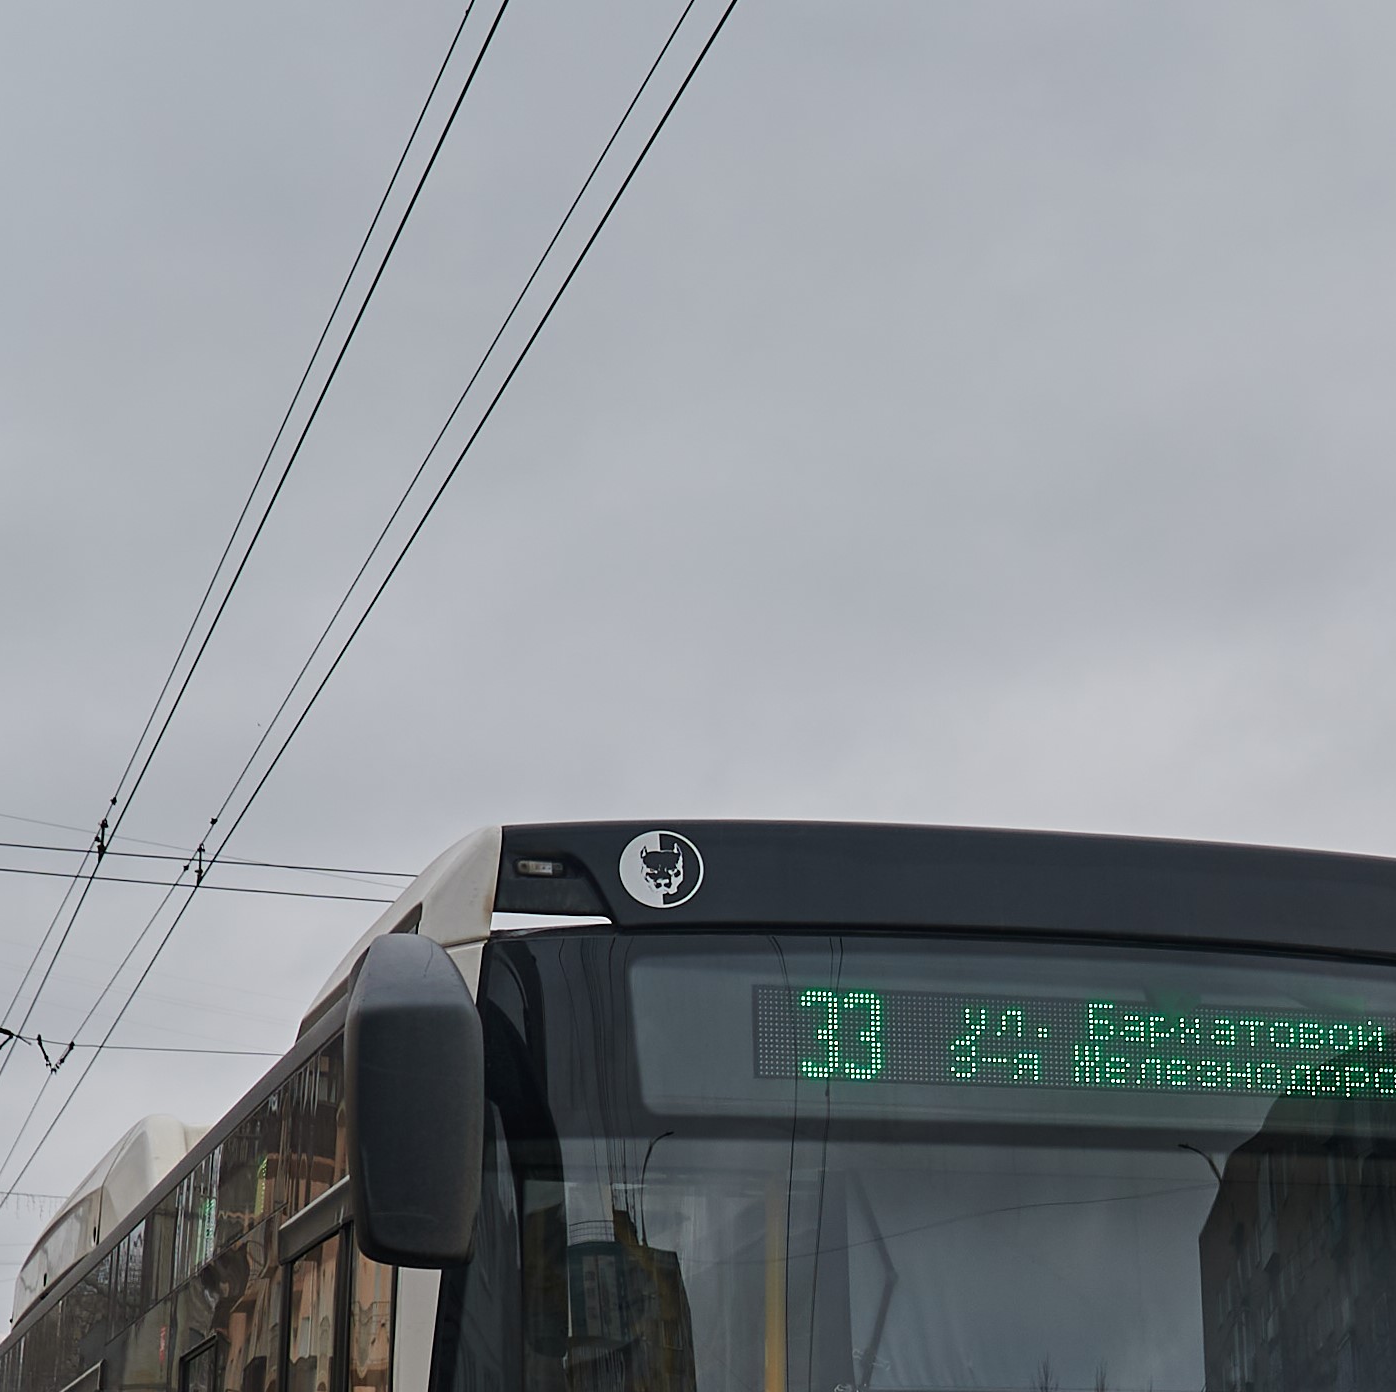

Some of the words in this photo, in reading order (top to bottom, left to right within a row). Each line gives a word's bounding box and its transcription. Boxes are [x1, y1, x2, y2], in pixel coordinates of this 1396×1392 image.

[800, 990, 882, 1079] 33
[963, 1007, 1049, 1040] ул.
[1088, 1002, 1384, 1052] Бархатовой
[950, 1039, 1039, 1081] 3-я
